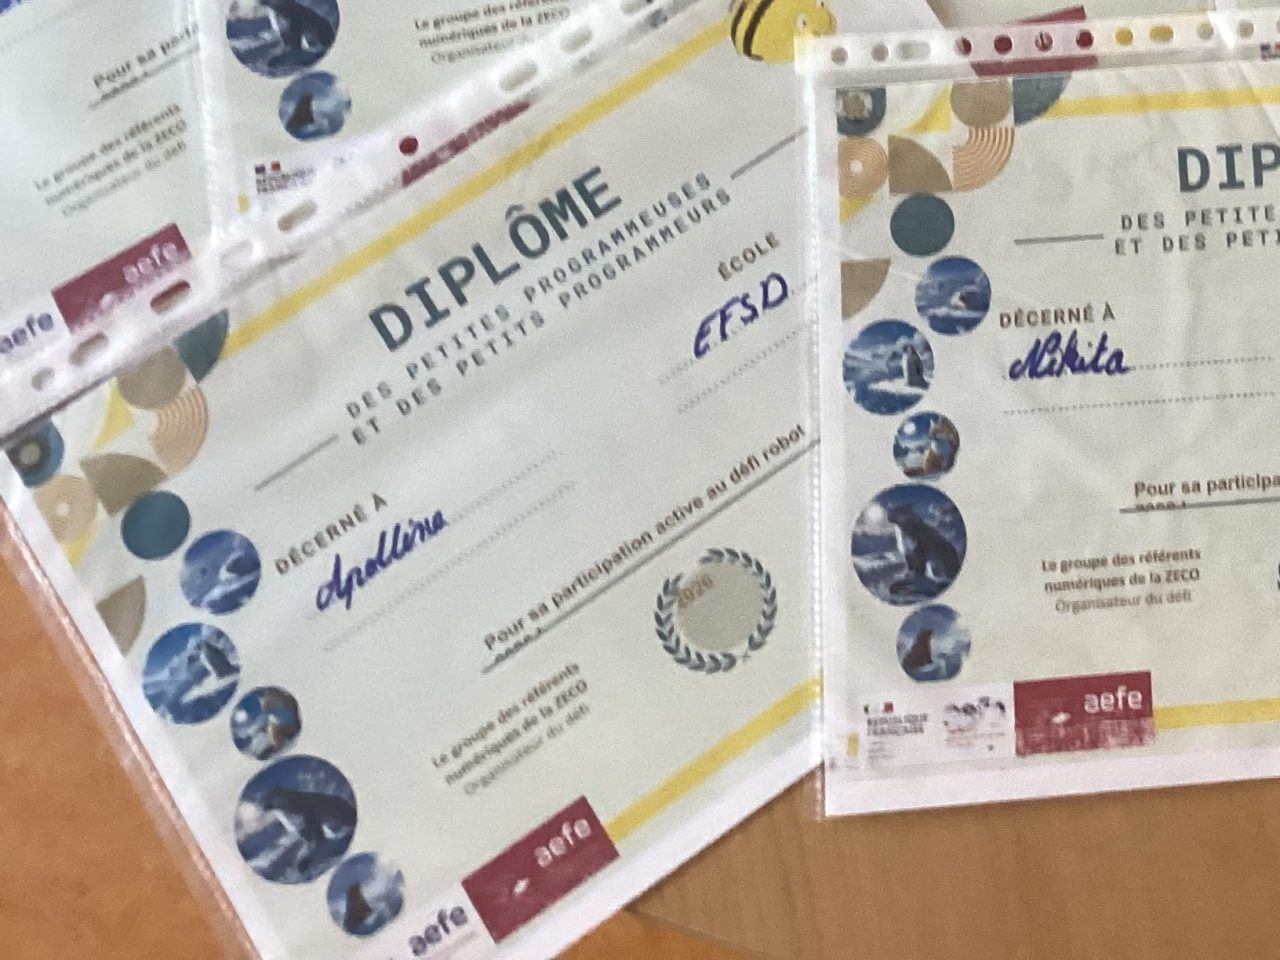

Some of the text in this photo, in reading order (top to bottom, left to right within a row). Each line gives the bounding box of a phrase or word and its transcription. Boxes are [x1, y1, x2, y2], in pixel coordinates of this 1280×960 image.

[1120, 211, 1166, 231] DES
[1114, 238, 1142, 256] ET
[1162, 232, 1207, 253] DES
[368, 166, 623, 352] DIPLÔME
[346, 172, 711, 419] DES PETITES PROGRAMMEUSES
[352, 187, 731, 445] ET DES PETITS PROGRAMMEURS
[999, 304, 1094, 330] DÉCERNÉ
[1008, 329, 1131, 381] Nikita
[1134, 480, 1175, 497] Pour
[1181, 480, 1201, 494] sa
[274, 503, 368, 575] DÉCERNÉ
[483, 616, 524, 650] Pour
[527, 602, 549, 620] sa
[551, 530, 653, 608] participation
[655, 497, 704, 536] active
[706, 480, 727, 500] au
[728, 455, 760, 484] défi
[761, 423, 806, 464] robot
[1042, 548, 1201, 574] Le groupe des référents
[1044, 567, 1200, 592] numériques de la ZECO
[1084, 685, 1143, 713] aefe
